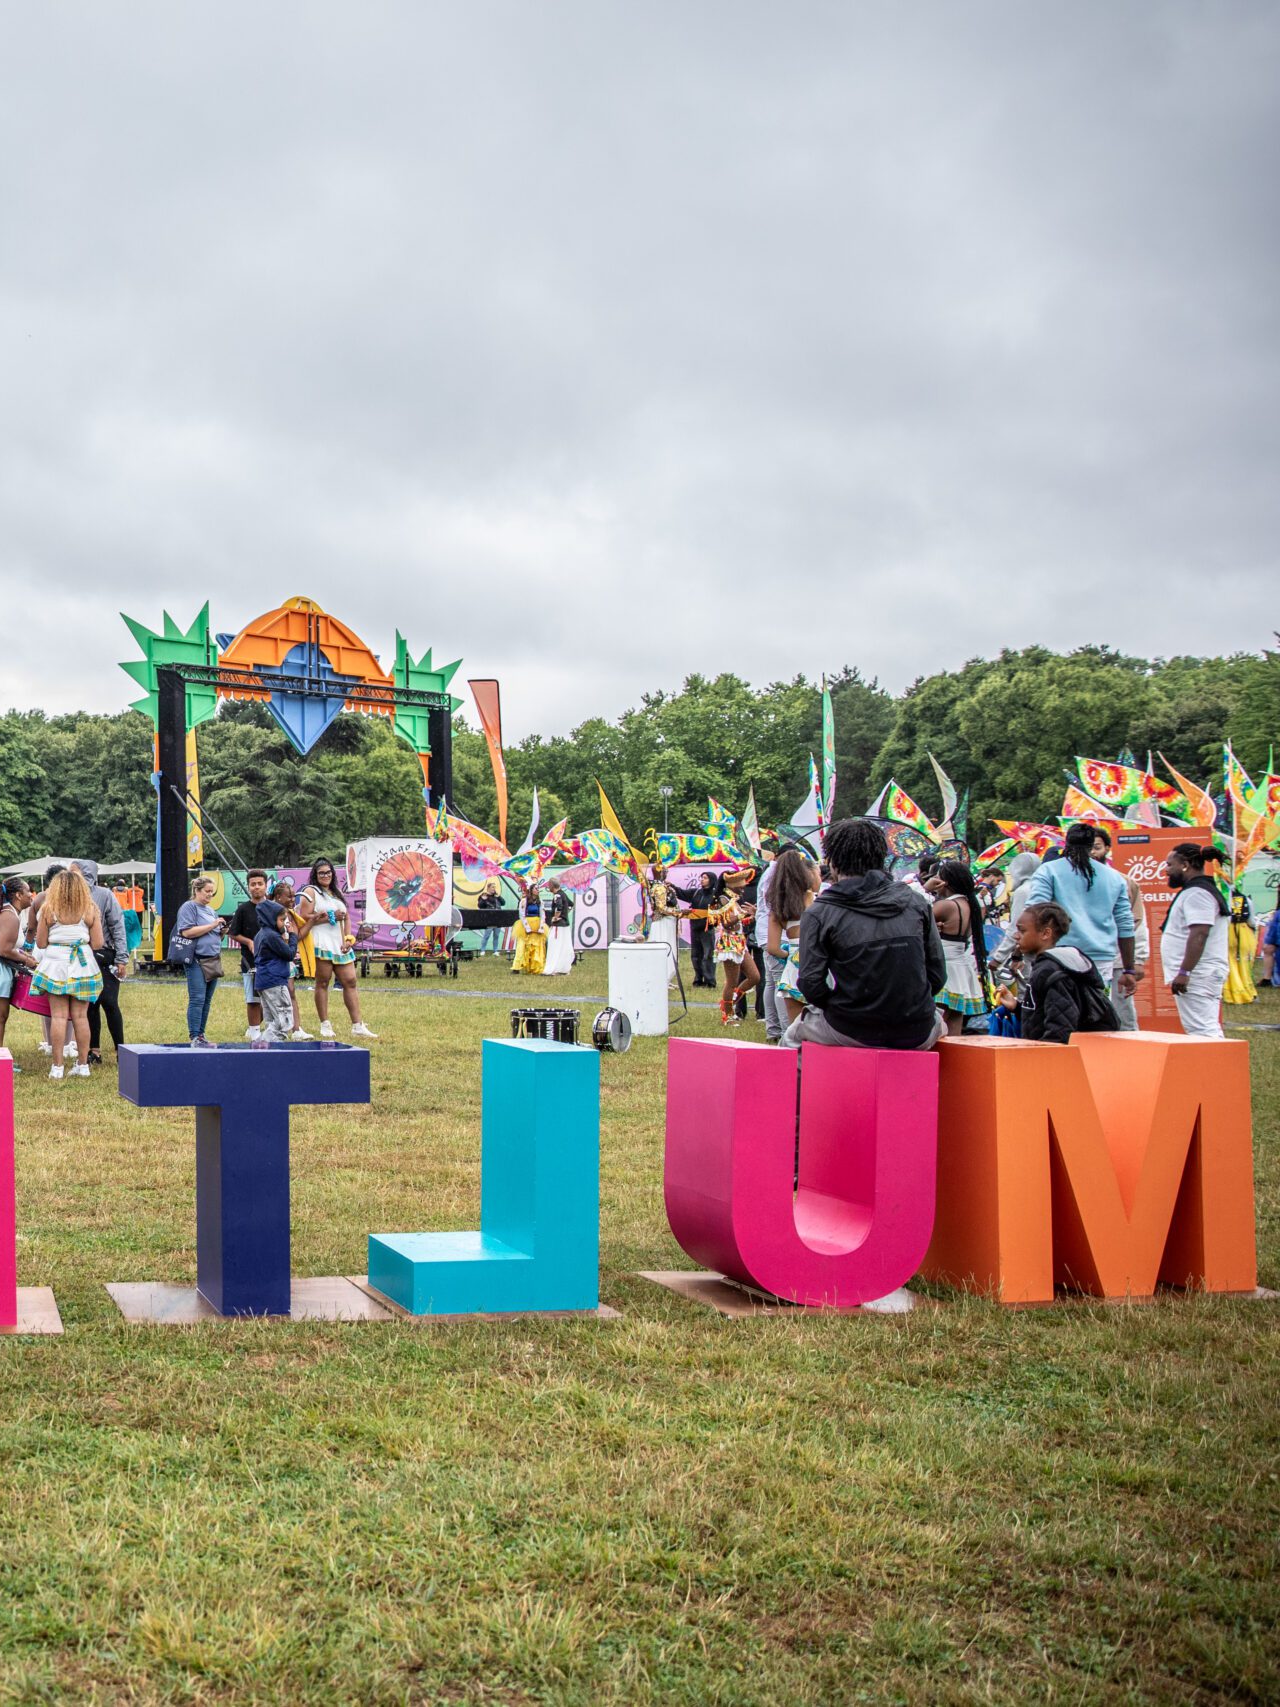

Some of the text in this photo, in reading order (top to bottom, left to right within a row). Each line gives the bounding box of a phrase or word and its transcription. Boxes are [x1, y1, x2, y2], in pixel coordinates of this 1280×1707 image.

[370, 843, 411, 873] Tribago
[417, 842, 448, 874] France
[1127, 860, 1168, 881] Bel
